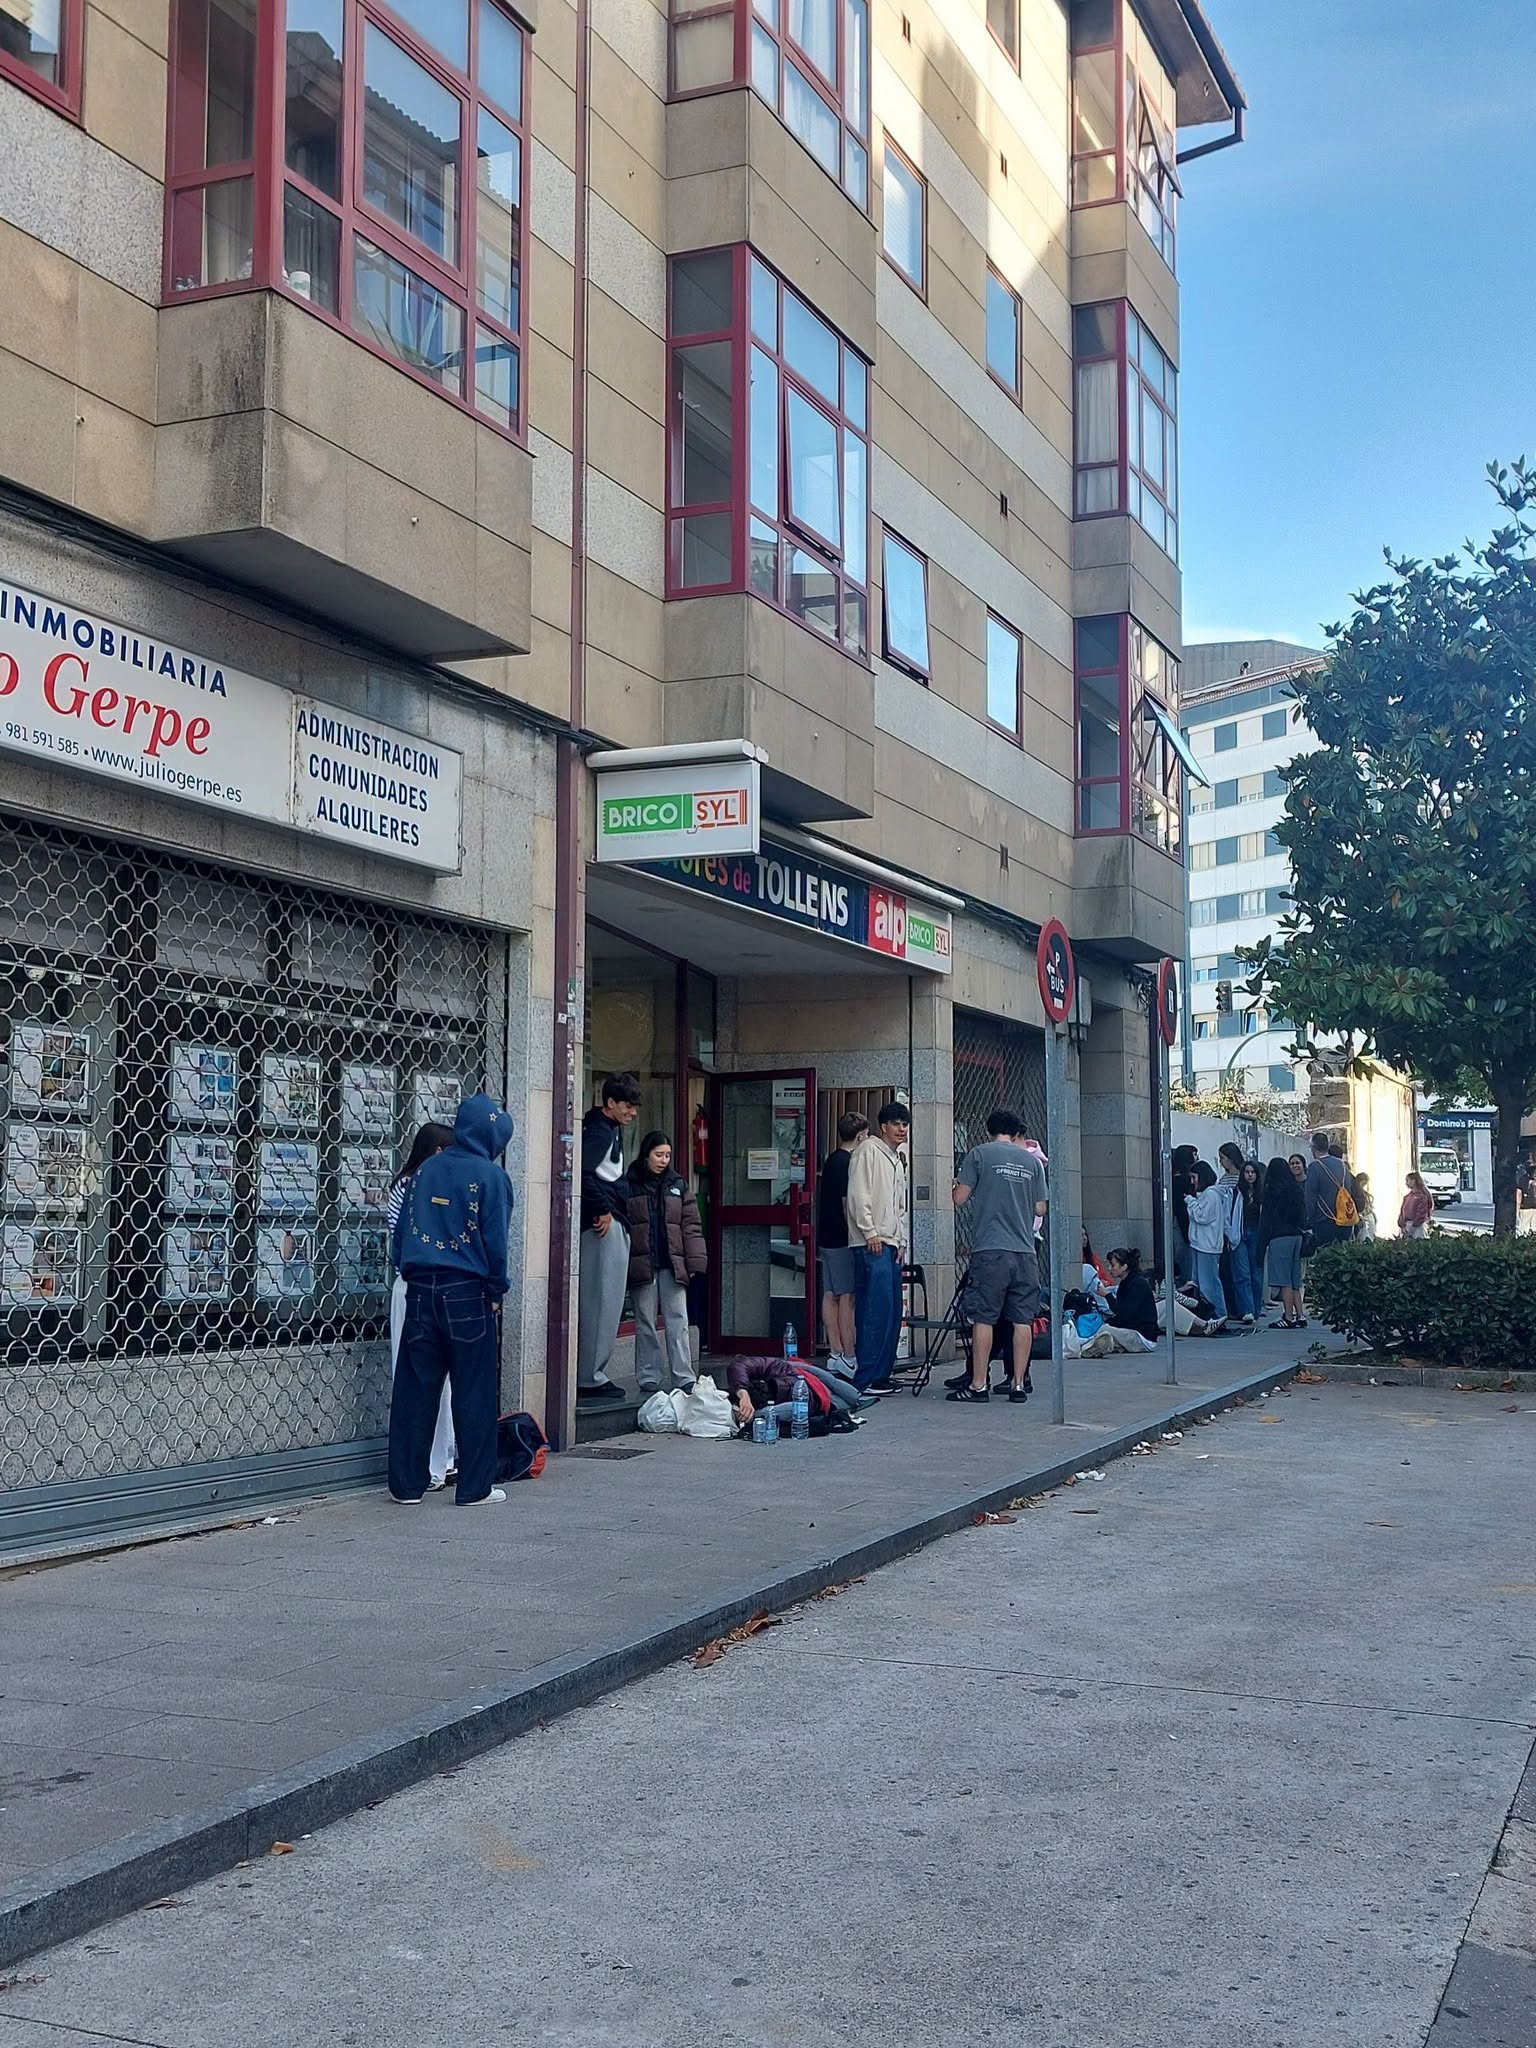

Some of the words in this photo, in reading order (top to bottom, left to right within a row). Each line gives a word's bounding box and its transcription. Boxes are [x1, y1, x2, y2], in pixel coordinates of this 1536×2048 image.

[0, 590, 227, 698] INMOBILIARIA
[43, 652, 211, 758] Gerpe
[5, 721, 28, 742] 981
[32, 730, 54, 749] 591
[57, 737, 79, 756] 585
[90, 745, 243, 803] www.juliogerpe.es
[296, 710, 439, 780] ADMINISTRACION
[308, 753, 428, 813] COMUNIDADES
[316, 796, 420, 847] ALQUILERES
[608, 802, 679, 829] BRICO
[696, 798, 737, 822] SYL
[733, 861, 752, 895] de
[754, 855, 849, 927] TOLLENS
[909, 921, 931, 945] BRICO
[1055, 951, 1061, 967] P
[1050, 976, 1065, 994] BUS
[1427, 1118, 1466, 1128] Domino's
[1467, 1119, 1491, 1128] Pizza
